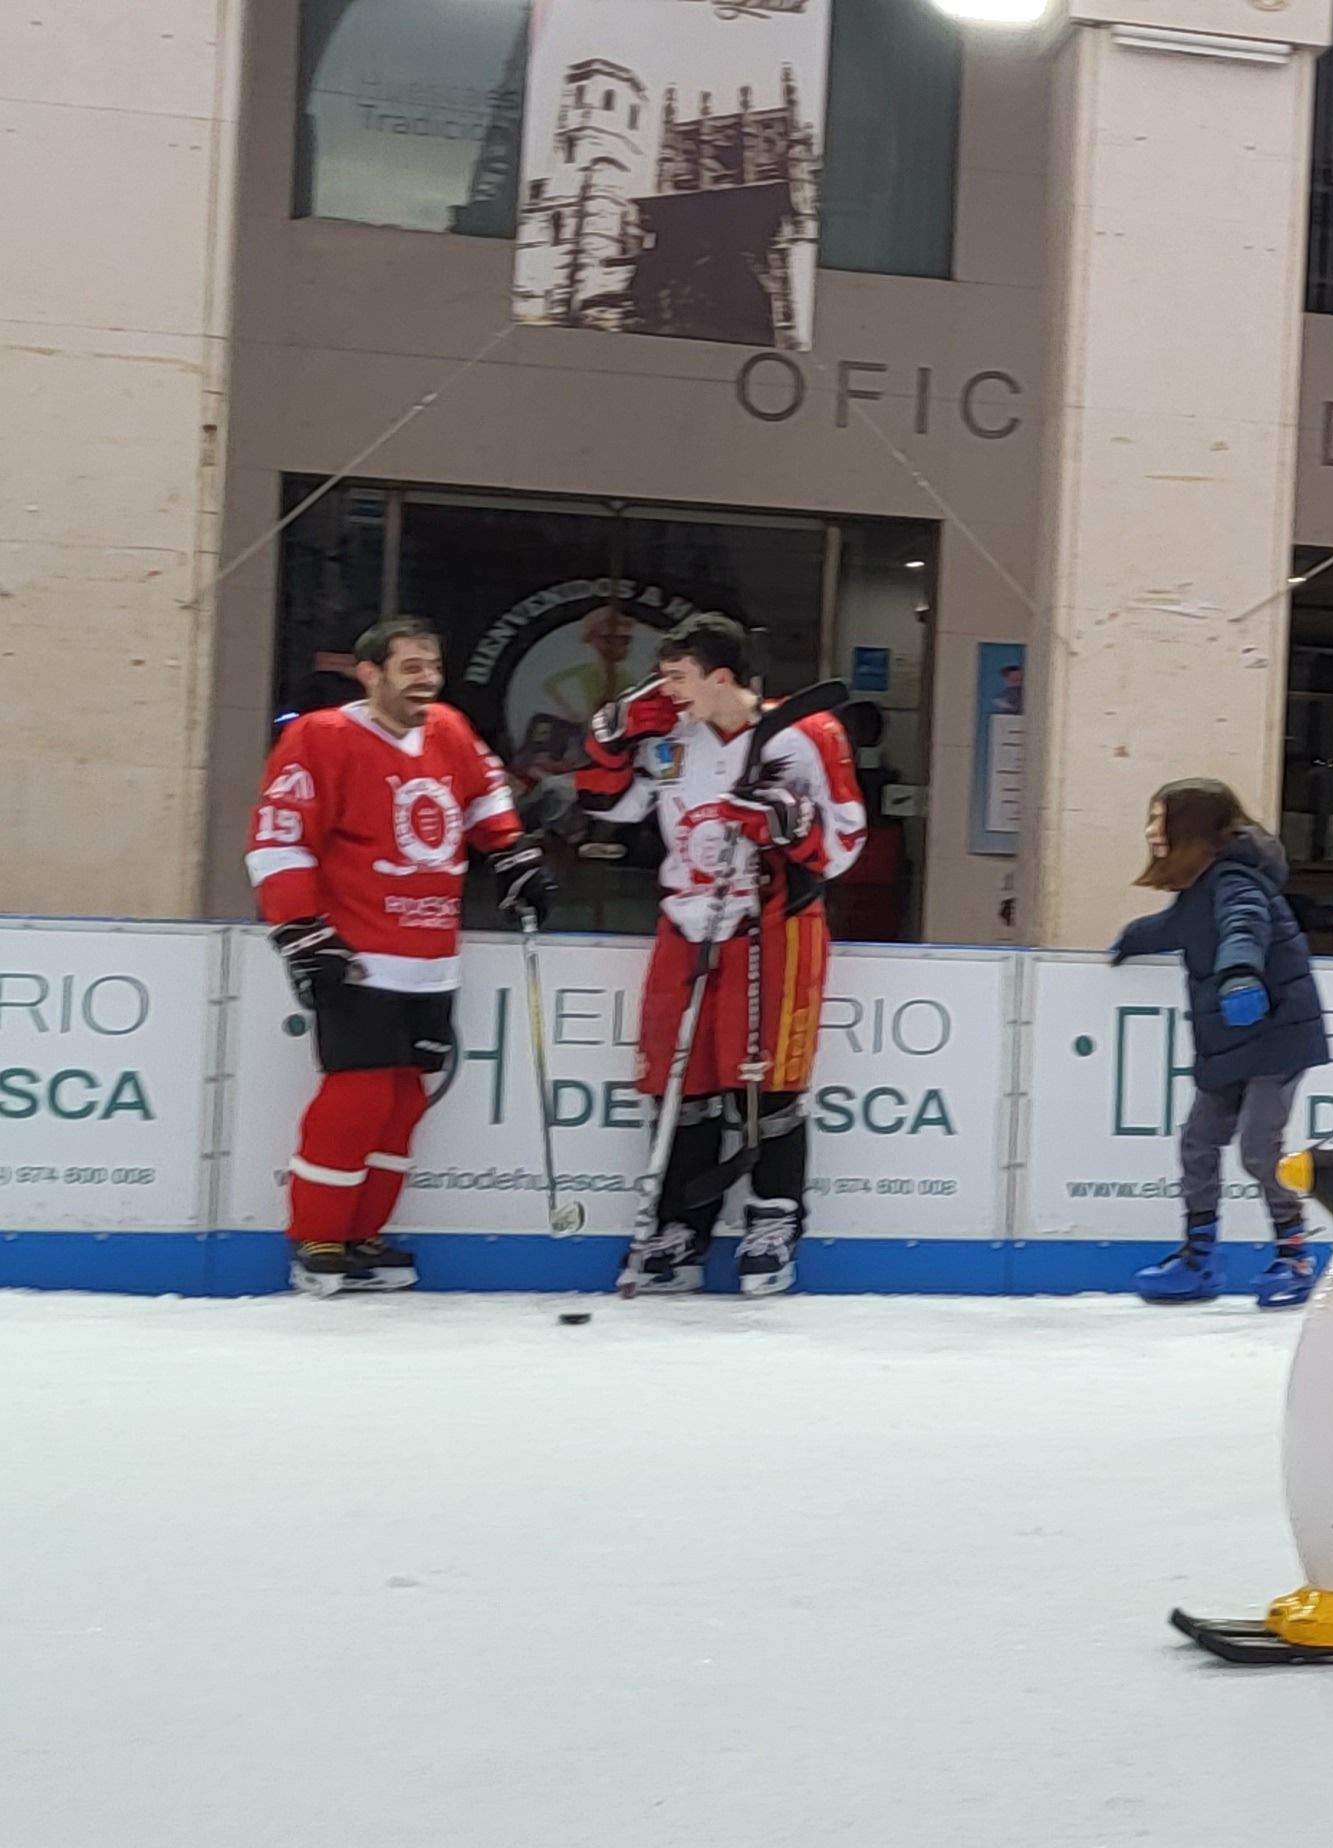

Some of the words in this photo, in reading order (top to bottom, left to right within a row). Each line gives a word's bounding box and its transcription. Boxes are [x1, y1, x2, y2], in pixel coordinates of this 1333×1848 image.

[736, 351, 1023, 440] OFIC
[463, 576, 639, 685] BIENVENIDOS
[0, 972, 150, 1036] RIO
[820, 997, 952, 1056] RIO
[0, 1067, 156, 1121] SCA
[814, 1085, 958, 1136] SCA
